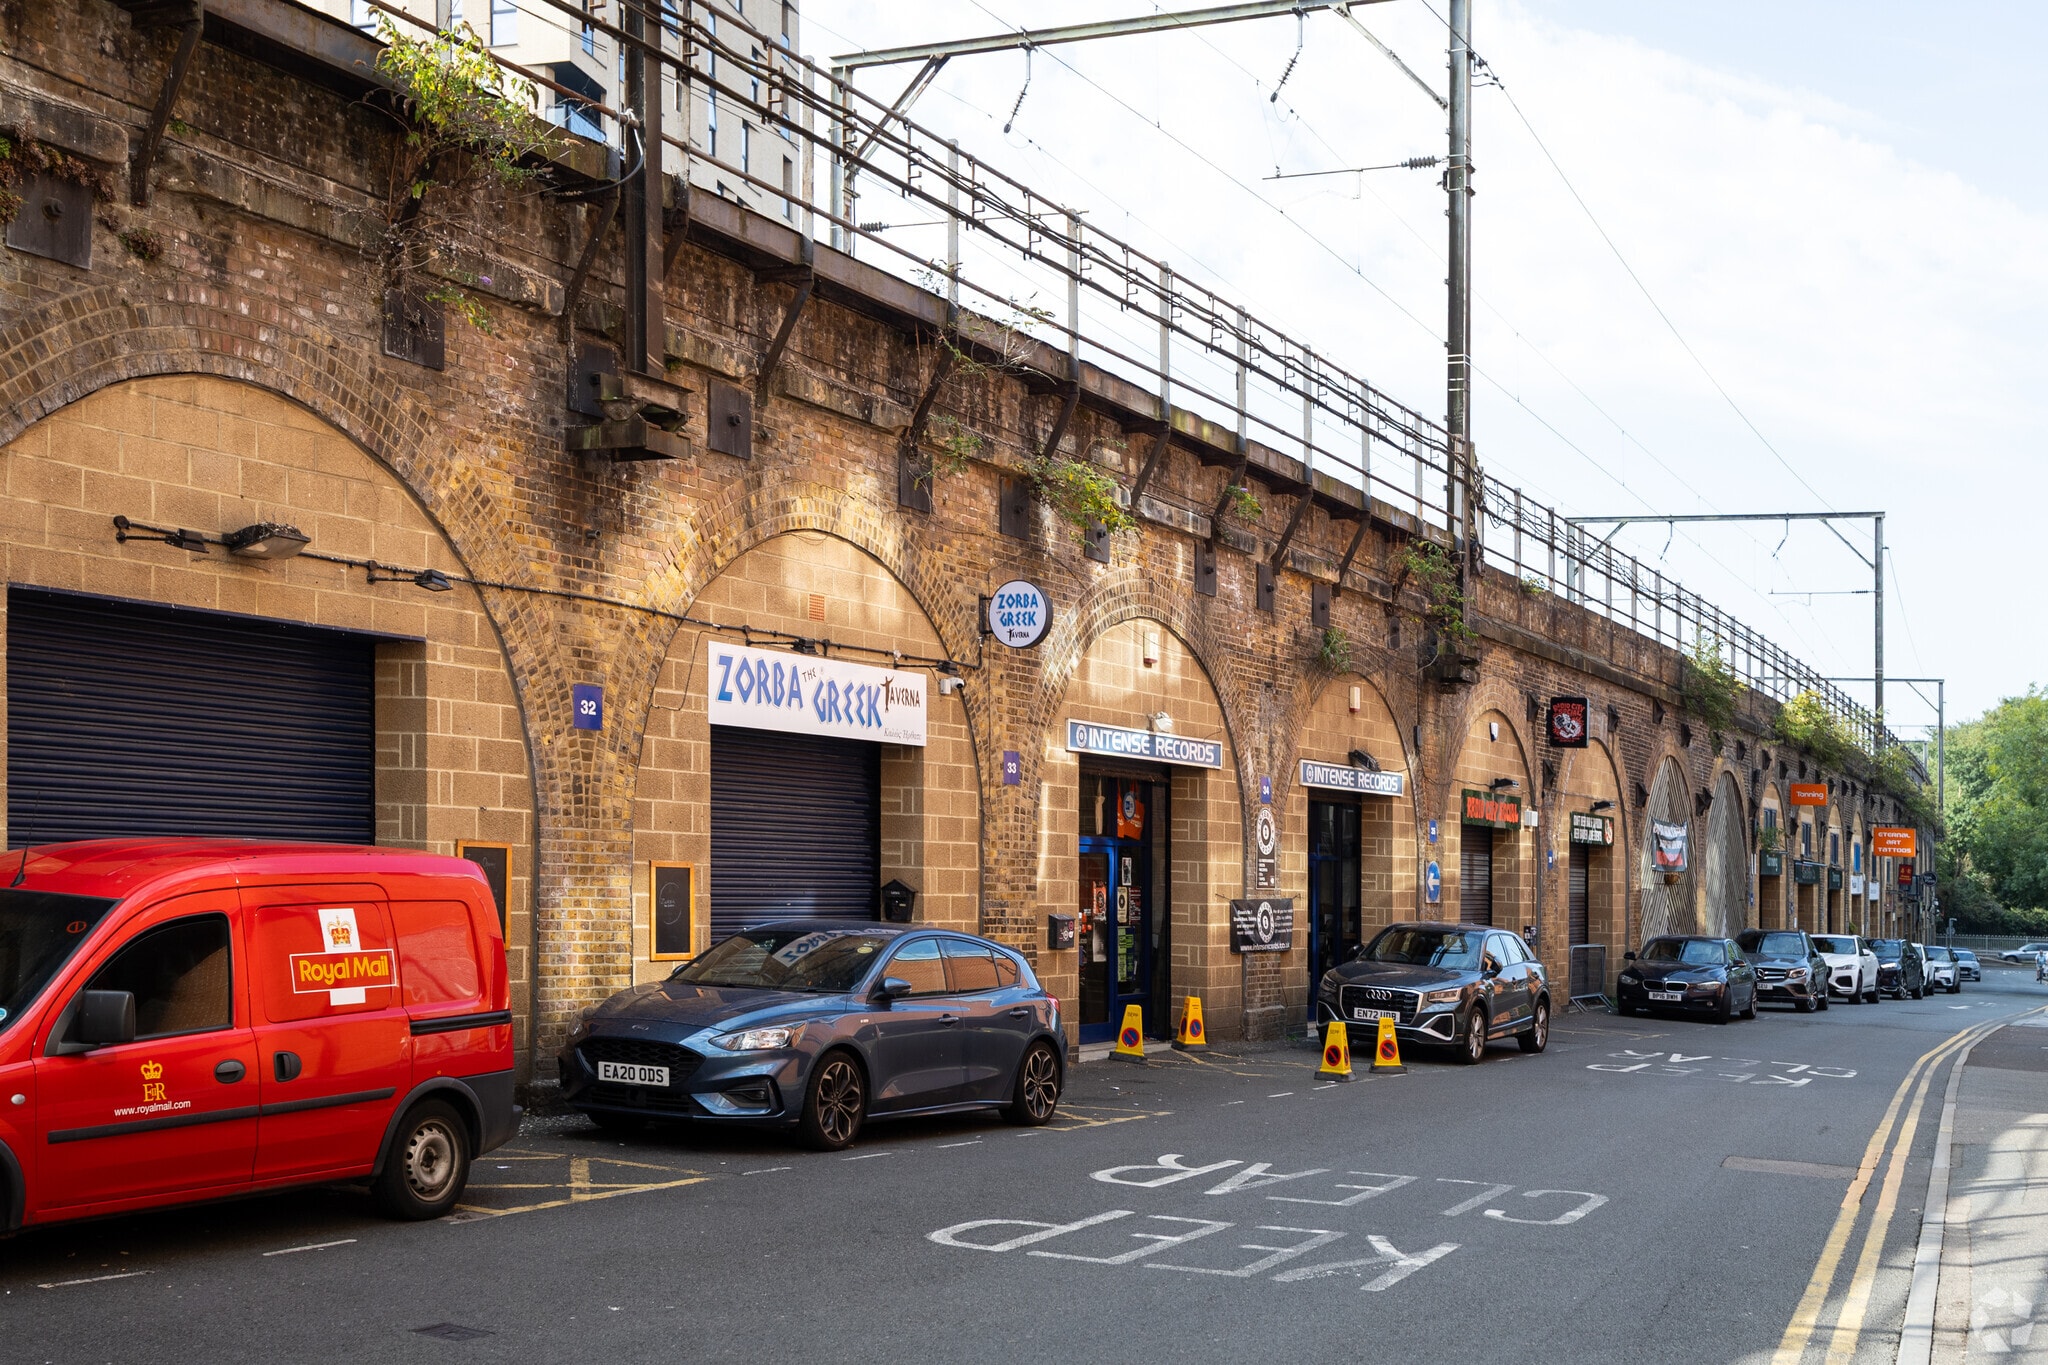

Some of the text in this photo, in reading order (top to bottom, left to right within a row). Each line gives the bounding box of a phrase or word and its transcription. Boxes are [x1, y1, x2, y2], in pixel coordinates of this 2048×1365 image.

[998, 593, 1038, 609] ZORBA
[1000, 611, 1037, 627] GREEK
[717, 654, 804, 711] ZORBA
[802, 667, 817, 683] THE
[813, 679, 883, 729] GREEK
[580, 699, 597, 715] 32
[1089, 727, 1215, 763] INTENSE RECORDS
[1007, 762, 1017, 774] 33
[1314, 766, 1398, 791] INTENSE RECORDS
[1263, 786, 1270, 795] 34
[1796, 791, 1824, 800] Tanning
[299, 955, 389, 985] Royal Mail
[1357, 1008, 1379, 1019] EN72
[603, 1064, 664, 1083] EA20 ODS
[114, 1100, 191, 1116] www.royalmail.com
[1089, 1153, 1609, 1225] CLEAR
[925, 1210, 1461, 1291] KEEP
